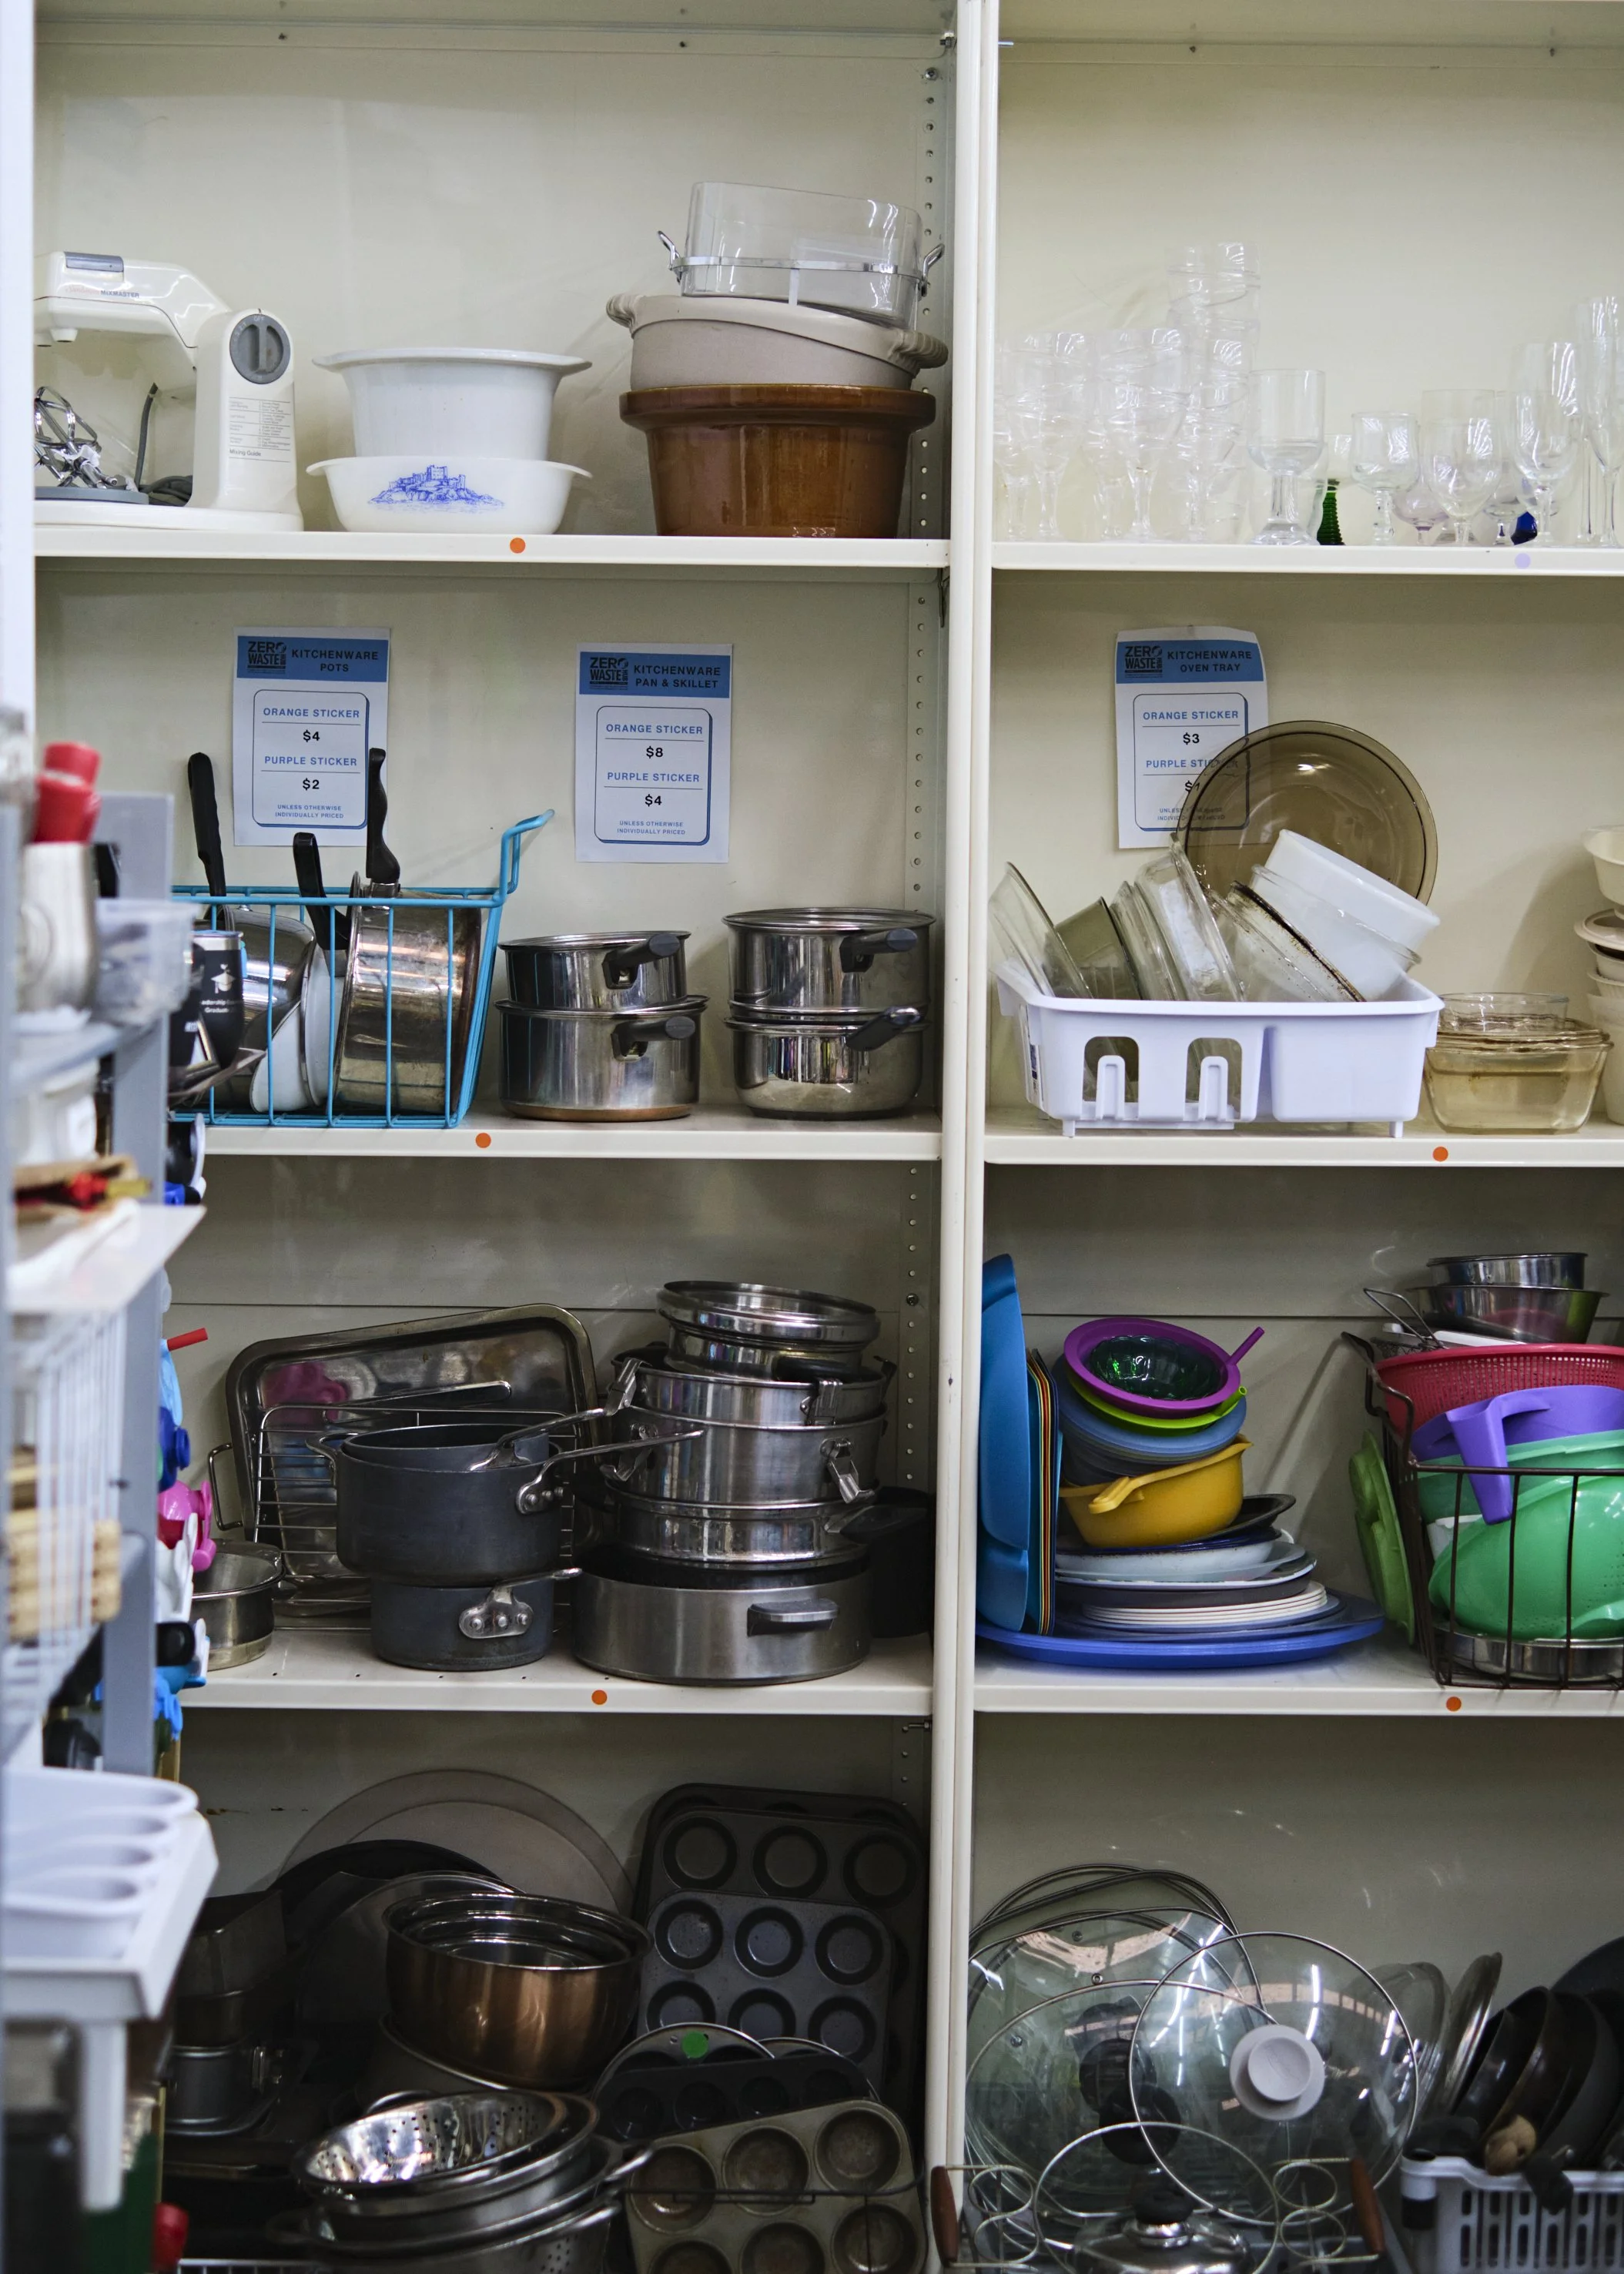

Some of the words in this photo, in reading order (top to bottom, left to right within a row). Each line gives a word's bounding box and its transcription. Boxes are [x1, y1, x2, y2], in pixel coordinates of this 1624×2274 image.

[248, 641, 286, 652] ZERO
[1125, 646, 1163, 656] ZERO
[248, 653, 280, 665] WASTE
[292, 649, 378, 660] KITCHENWARE
[1167, 651, 1251, 659] KITCHENWARE
[320, 663, 348, 671] POTS
[590, 658, 628, 668] ZERO
[1126, 658, 1157, 668] WASTE
[635, 665, 721, 675] KITCHENWARE
[590, 670, 621, 681] WASTE
[636, 678, 657, 687] PAN
[662, 678, 668, 687] &
[673, 679, 718, 688] SKILLET
[263, 708, 308, 716] ORANGE
[313, 709, 359, 718] STICKER
[1143, 712, 1187, 720] ORANGE
[1192, 711, 1238, 719] STICKER
[606, 724, 651, 732] ORANGE
[656, 725, 702, 734] STICKER
[303, 730, 320, 742] $4
[1184, 732, 1199, 745] $3
[646, 746, 663, 759] $8
[310, 757, 357, 765] STICKER
[608, 772, 648, 781] PURPLE
[653, 773, 699, 782] STICKER
[303, 778, 319, 790] $2
[645, 794, 661, 807] $4
